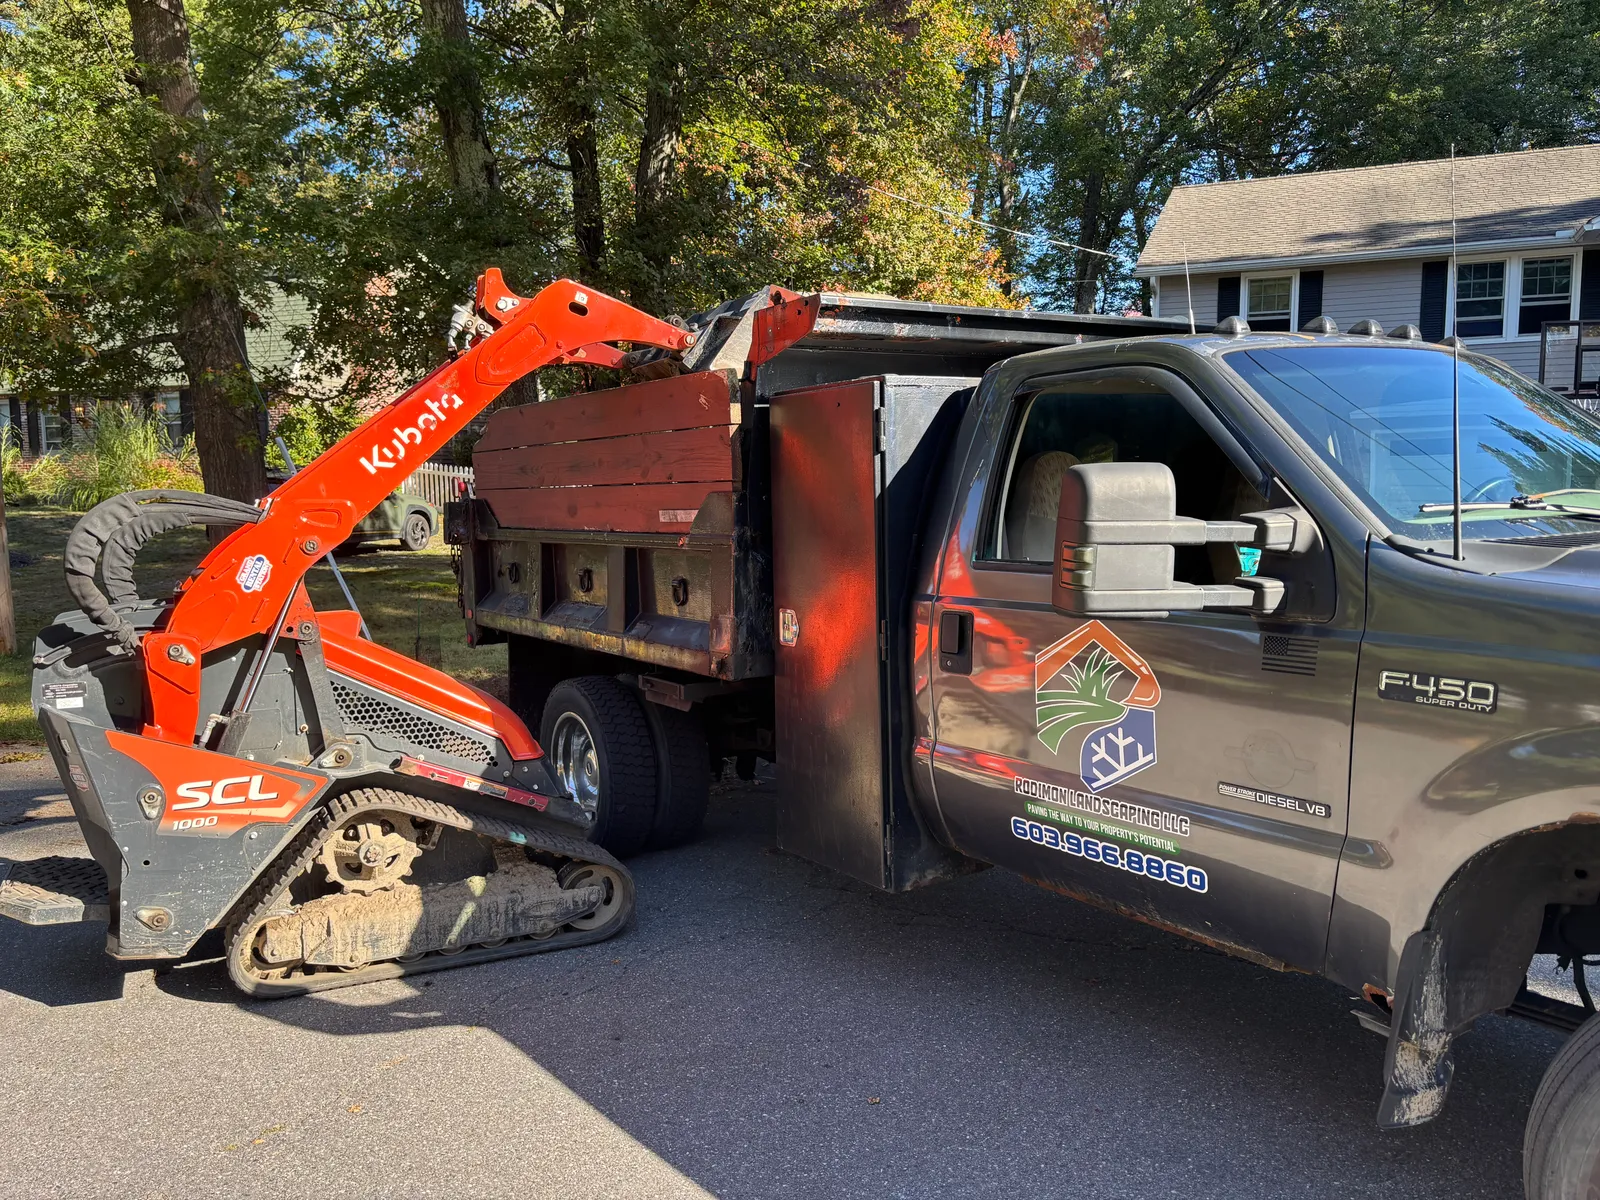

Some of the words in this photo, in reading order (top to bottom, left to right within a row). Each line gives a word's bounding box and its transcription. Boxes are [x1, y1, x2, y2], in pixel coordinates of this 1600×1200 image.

[359, 393, 464, 475] Kubota
[246, 560, 264, 588] RENTAL
[1415, 696, 1455, 707] SUPER
[1459, 702, 1492, 712] DUTY
[172, 775, 279, 811] SCL
[1014, 776, 1068, 806] RODIMON
[1068, 789, 1161, 830] LANDSCAPING
[1162, 811, 1190, 837] LLC
[1219, 784, 1237, 793] POWER
[1237, 788, 1257, 797] STROKE
[1256, 792, 1305, 812] DIESEL
[1306, 803, 1326, 817] V8
[172, 816, 218, 831] 1000
[1027, 803, 1048, 818] PAVING
[1048, 808, 1060, 821] THE
[1060, 812, 1075, 825] WAY
[1074, 816, 1083, 827] TO
[1083, 818, 1100, 832] YOUR
[1100, 823, 1139, 843] PROPERTY'S
[1139, 834, 1177, 853] POTENTIAL
[1011, 817, 1209, 894] 603.966.8860
